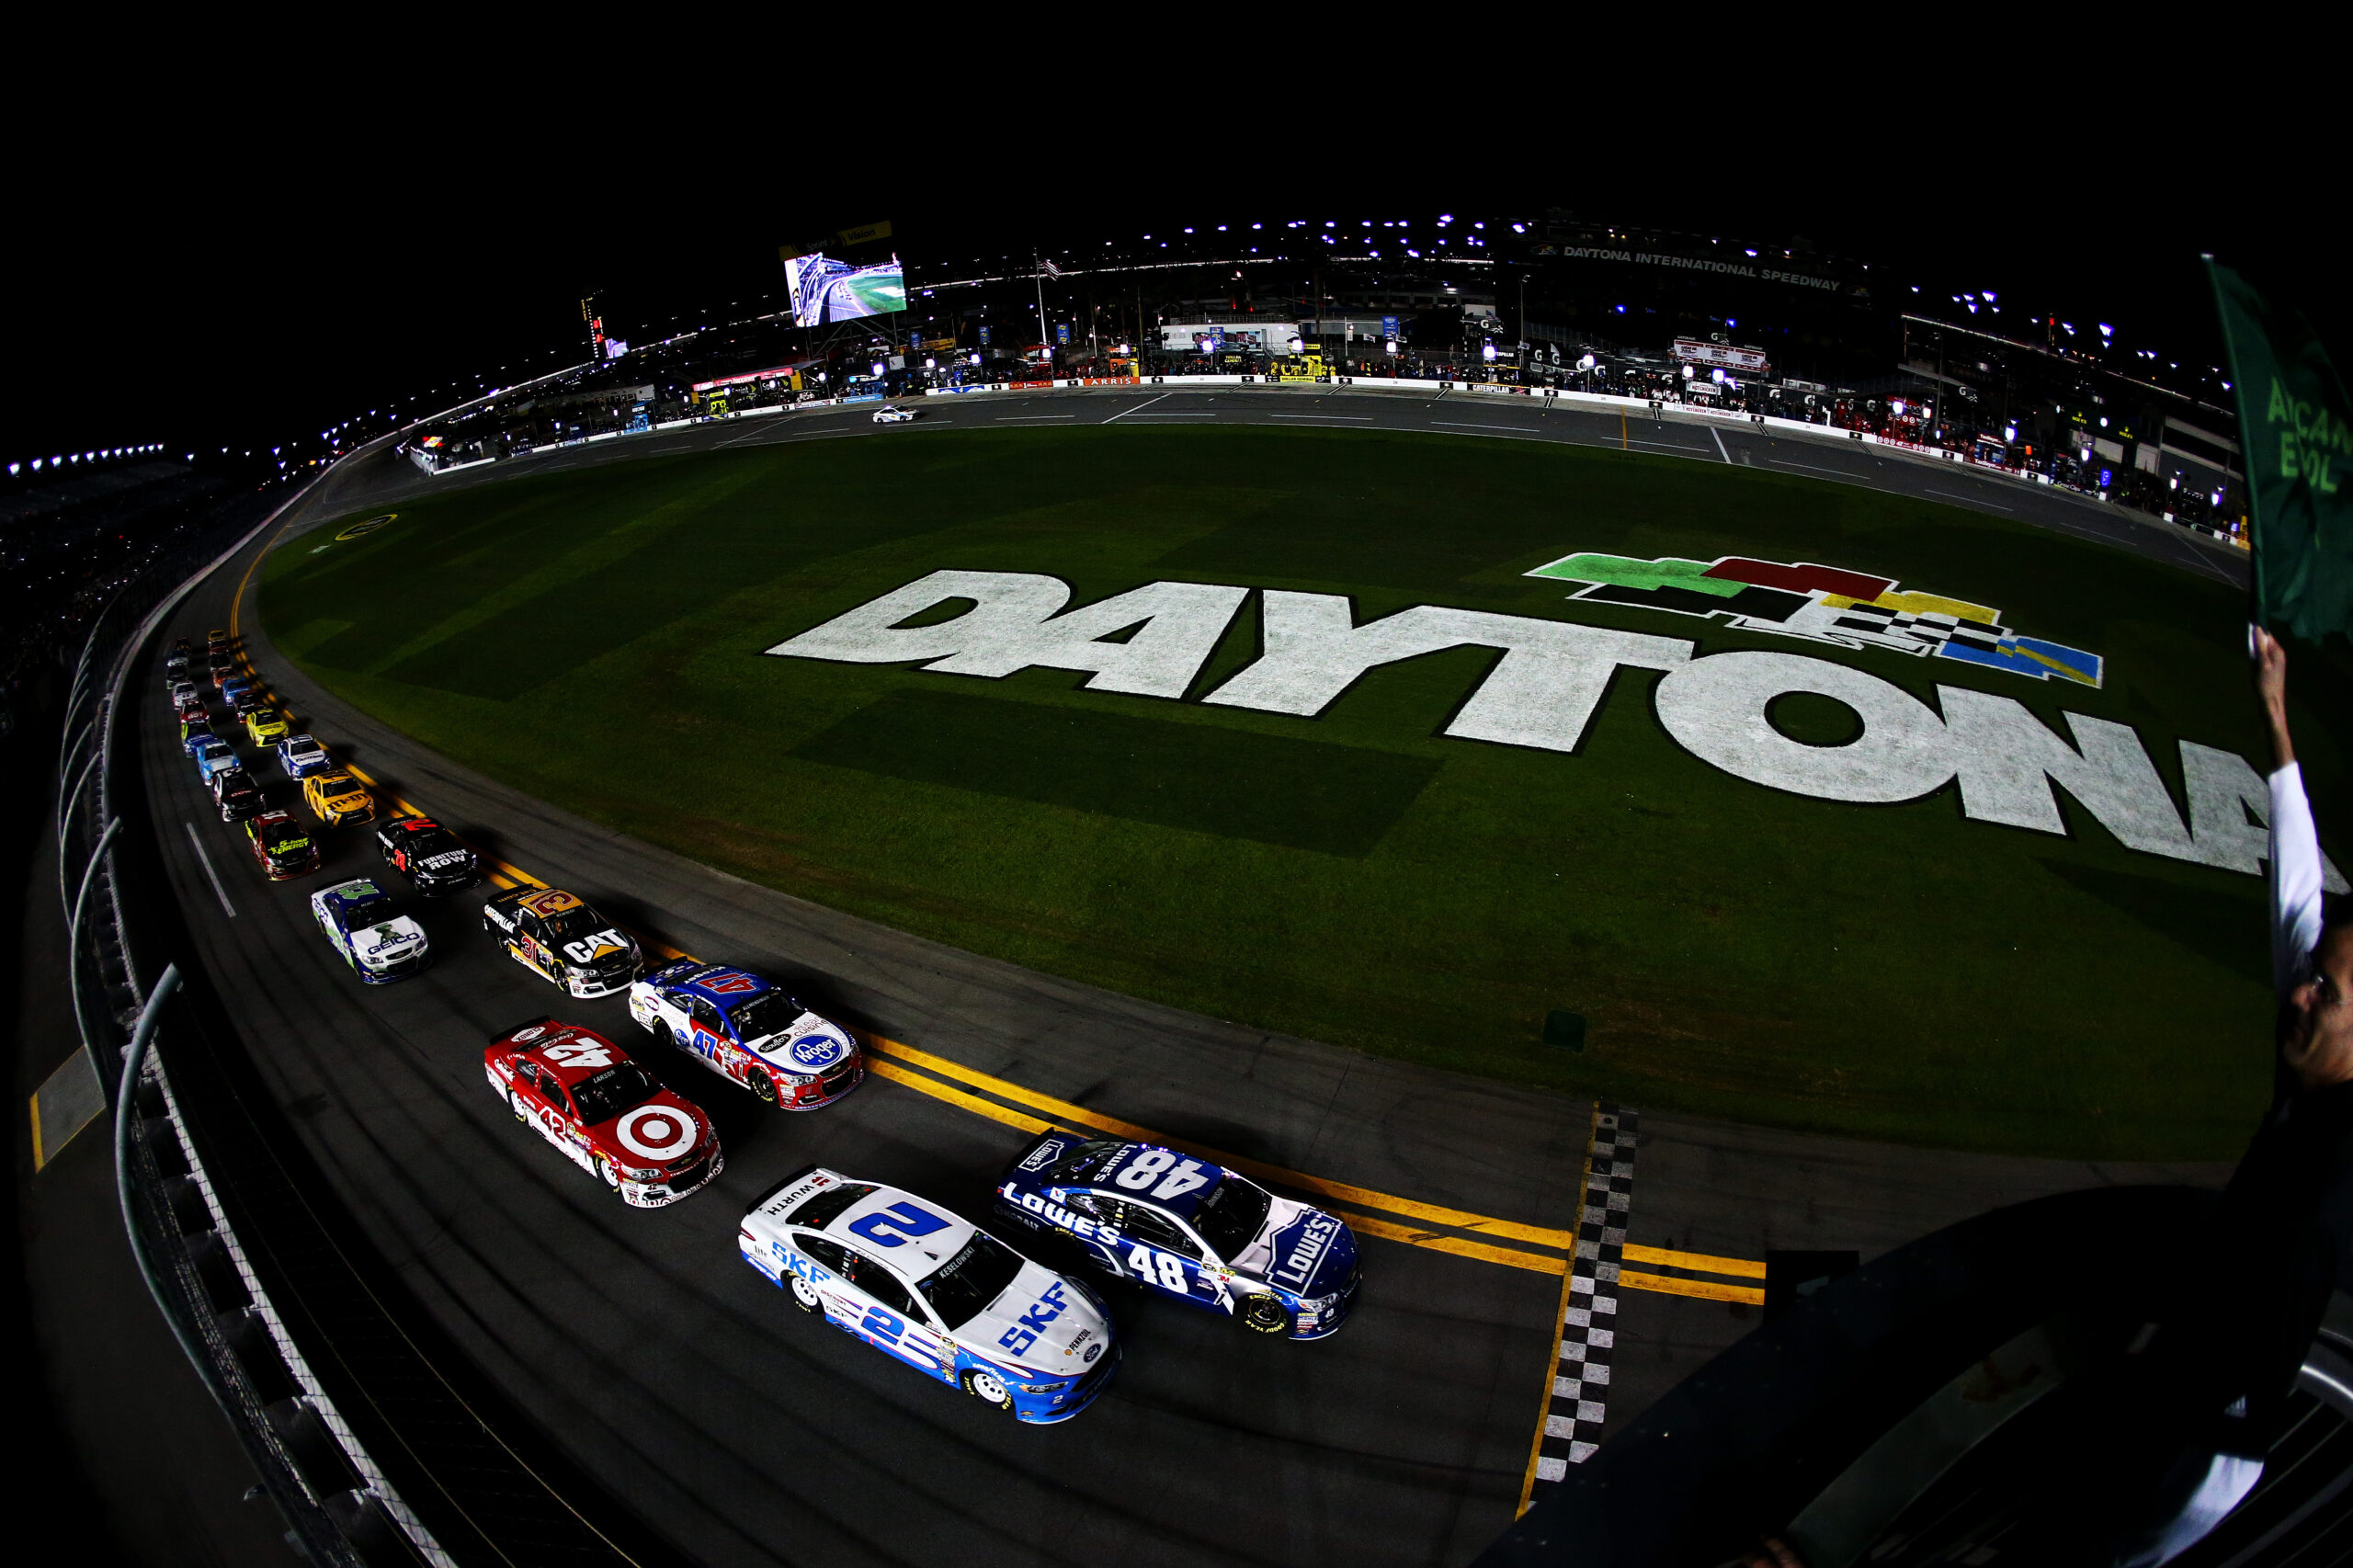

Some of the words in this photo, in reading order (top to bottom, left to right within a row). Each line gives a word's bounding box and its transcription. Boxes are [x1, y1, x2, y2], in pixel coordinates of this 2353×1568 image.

[847, 230, 876, 240] Vision
[1563, 246, 1631, 262] DAYTONA
[1636, 253, 1757, 277] INTERNATIONAL
[1761, 269, 1840, 292] SPEEDWAY
[1480, 319, 1489, 329] G
[1534, 349, 1542, 361] G
[1552, 354, 1560, 365] G
[1091, 378, 1132, 386] ARRIS
[1472, 384, 1510, 394] CATERPILLAR
[2072, 416, 2087, 425] ROLEX
[2119, 431, 2133, 439] ROLEX
[767, 568, 2353, 896] DAYTONA
[417, 848, 470, 868] FURNITURE
[428, 856, 466, 870] ROW
[529, 889, 574, 915] 31
[368, 933, 420, 955] GEICO
[520, 935, 538, 964] 31
[563, 927, 629, 964] CAT
[696, 973, 758, 994] 47
[542, 1037, 614, 1068] 42
[693, 1028, 720, 1060] 47
[760, 1035, 790, 1052] Stouffer's
[794, 1039, 835, 1062] Kroger
[593, 1069, 616, 1085] LARSON
[539, 1105, 568, 1144] 42
[1027, 1143, 1059, 1167] LOWE'S
[1092, 1144, 1139, 1183] LOWE'S
[1115, 1150, 1210, 1201] 48
[647, 1183, 658, 1192] 42
[767, 1185, 815, 1216] WÜRTH
[848, 1201, 952, 1248] 2
[1003, 1181, 1121, 1247] LOWE'S
[772, 1241, 831, 1283] SKF
[938, 1245, 976, 1279] KESELOWSKI
[1275, 1217, 1335, 1284] LOWE'S
[1128, 1243, 1188, 1295] 48
[1217, 1274, 1231, 1284] 3M
[861, 1306, 906, 1346] 2
[998, 1280, 1068, 1358] SKF
[1069, 1328, 1091, 1351] PENNZOIL
[1086, 1346, 1099, 1360] Ford
[1052, 1394, 1063, 1404] 2
